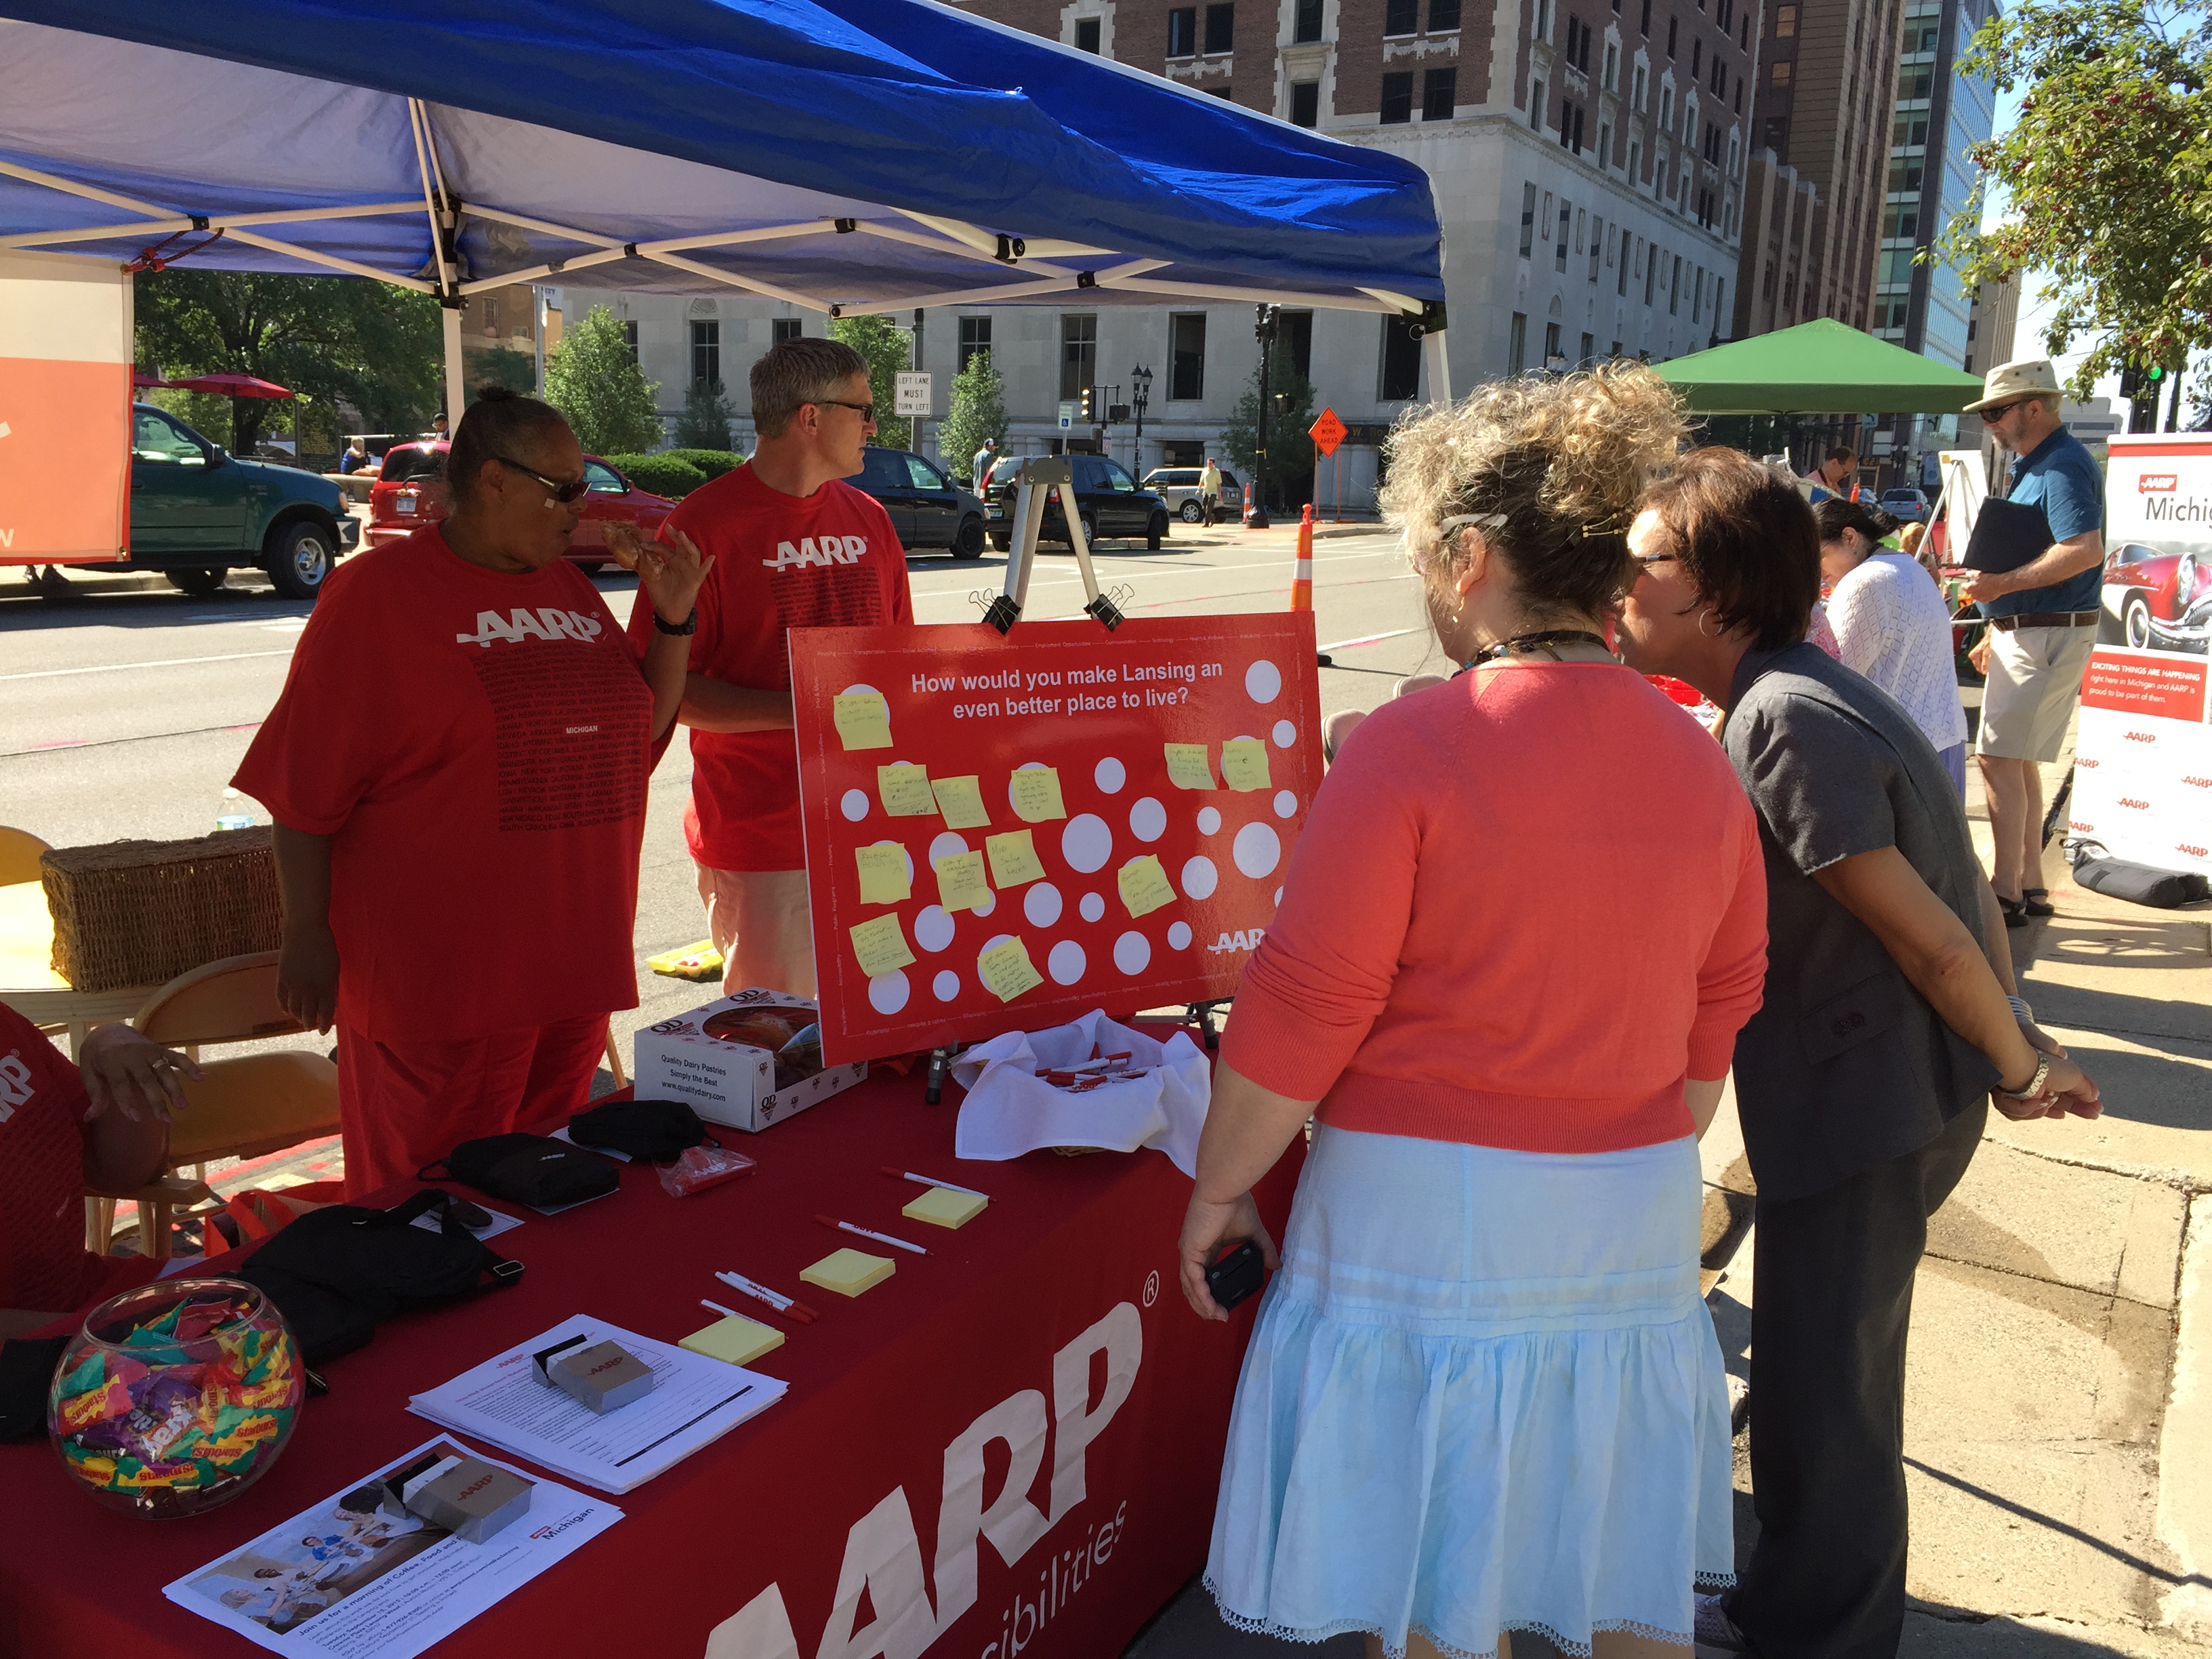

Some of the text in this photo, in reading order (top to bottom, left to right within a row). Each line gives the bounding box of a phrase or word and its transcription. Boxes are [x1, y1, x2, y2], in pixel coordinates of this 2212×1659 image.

[904, 390, 923, 398] MUST
[912, 661, 1223, 693] How would you make Lansing an
[2091, 661, 2200, 681] EXCITING THINGS ARE HAPPENING
[2090, 674, 2105, 684] right
[2105, 676, 2118, 684] here
[2127, 678, 2156, 690] Michigan
[2156, 682, 2169, 690] and
[2169, 683, 2189, 693] AARP
[2190, 686, 2195, 694] is
[953, 686, 1189, 719] even better place to live?
[2088, 687, 2107, 696] proud
[2115, 689, 2125, 697] be
[2125, 691, 2140, 701] part
[2140, 693, 2149, 701] of
[2149, 693, 2167, 703] them.
[565, 725, 599, 735] MICHIGAN
[2123, 731, 2156, 743] AARP
[2116, 798, 2150, 810] AARP
[2174, 844, 2209, 857] AARP
[1207, 928, 1265, 955] AAR
[729, 989, 760, 1003] QD
[650, 1019, 684, 1033] QD
[661, 1054, 726, 1076] Quality Dairy Pastries
[670, 1069, 718, 1087] Simply the Best
[661, 1080, 726, 1103] www.qualitydairy.com
[761, 1094, 777, 1109] QD
[587, 1355, 623, 1376] AARP
[234, 1417, 278, 1439] Starburst
[139, 1463, 193, 1482] Starburst
[457, 1474, 494, 1502] AARP
[542, 1507, 595, 1540] Michigan
[298, 1622, 316, 1636] Join
[317, 1616, 328, 1624] us
[327, 1608, 341, 1618] for
[349, 1584, 384, 1607] morning
[382, 1577, 392, 1585] of
[392, 1559, 422, 1580] Coffee,
[420, 1547, 441, 1562] Food
[442, 1539, 457, 1549] and
